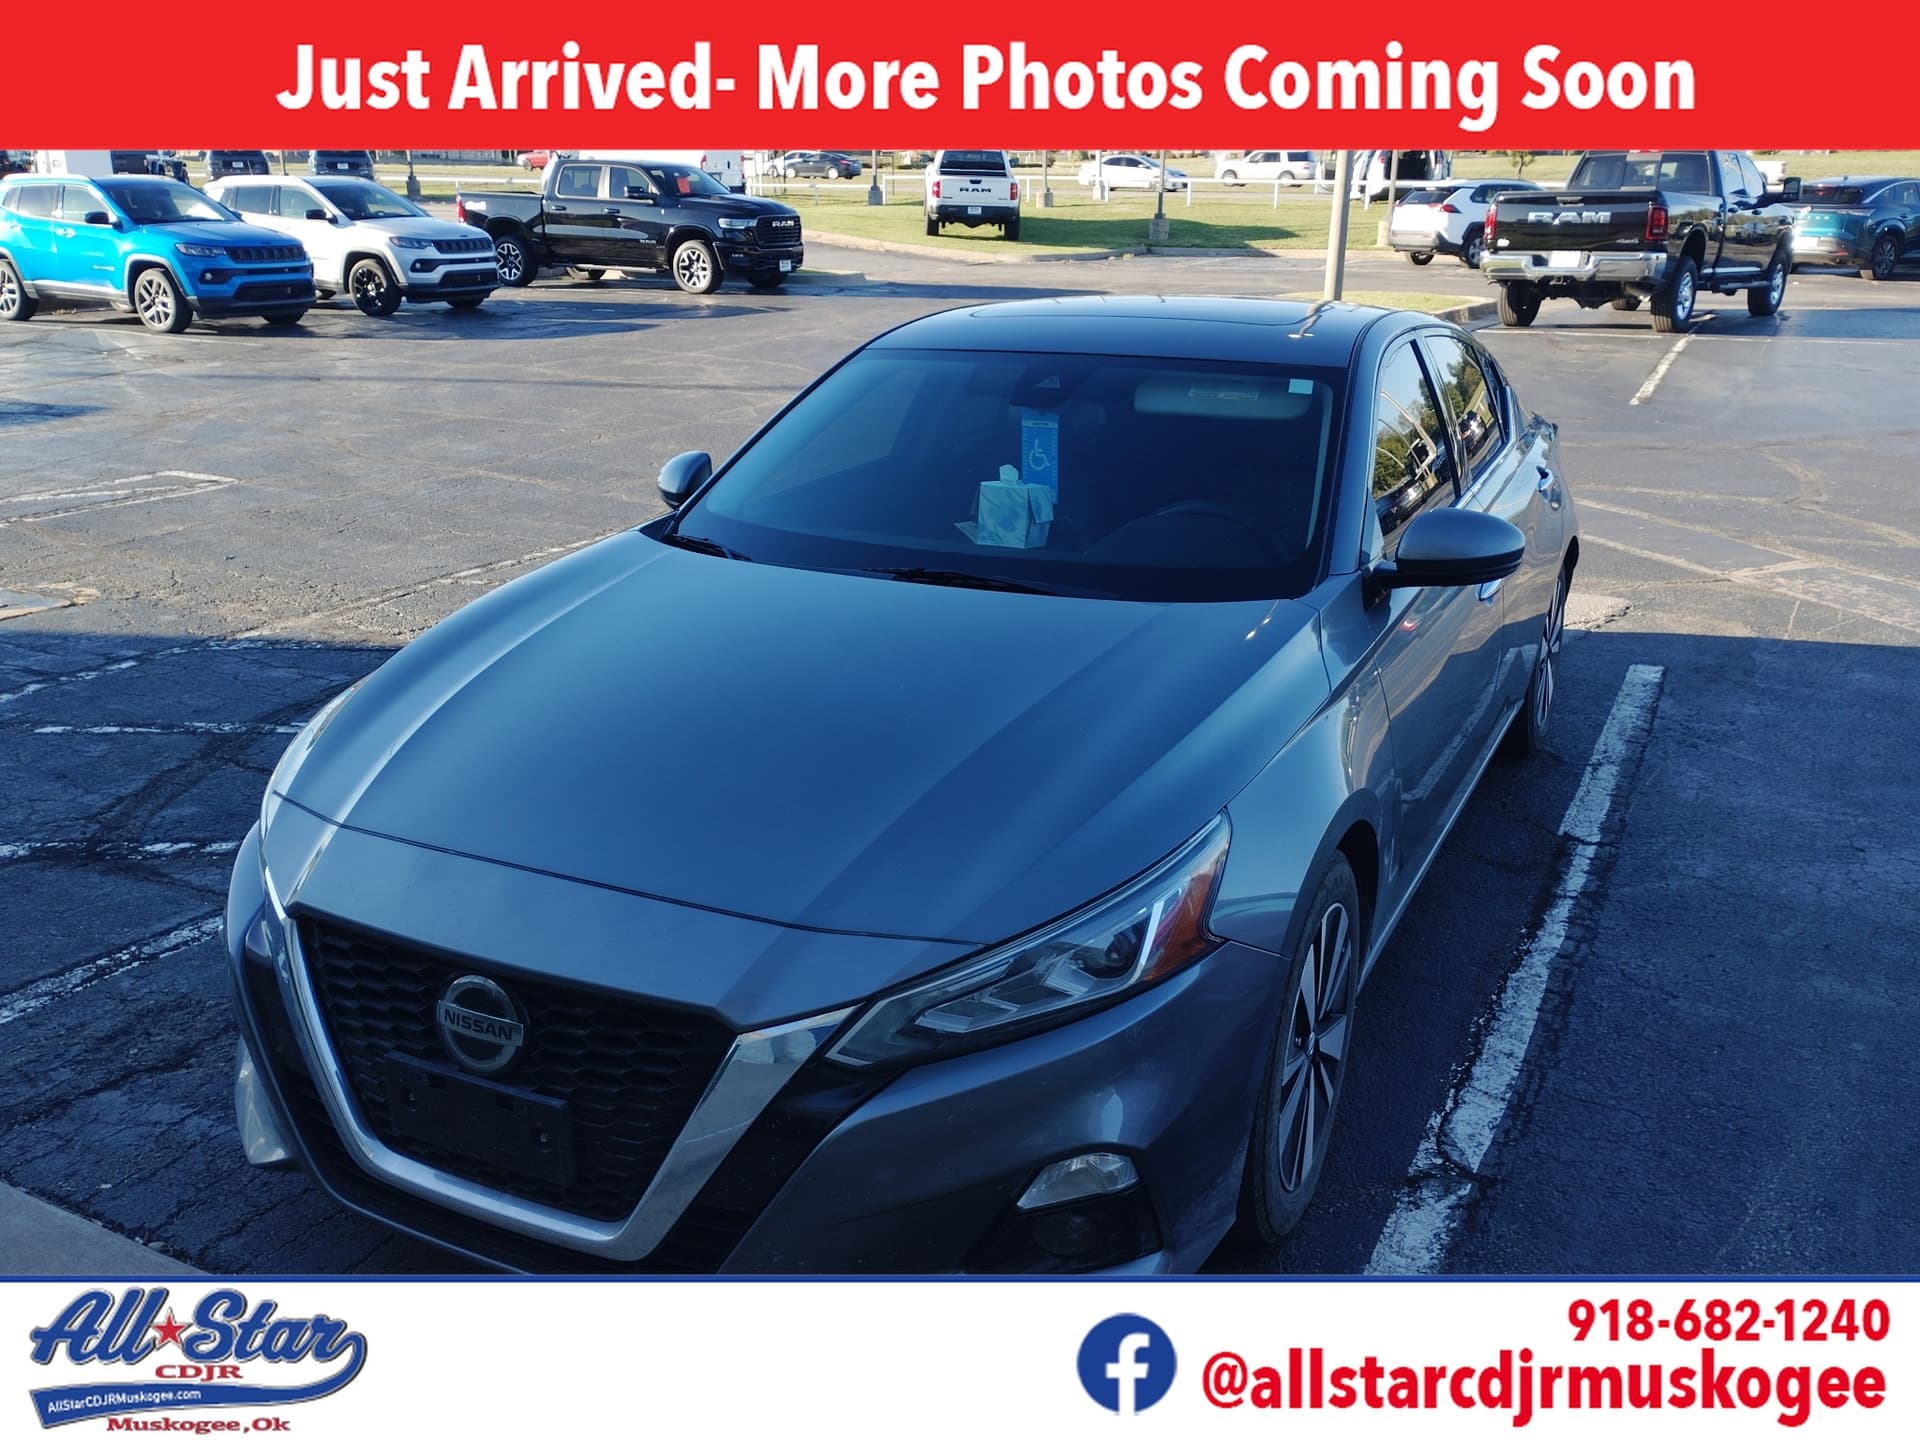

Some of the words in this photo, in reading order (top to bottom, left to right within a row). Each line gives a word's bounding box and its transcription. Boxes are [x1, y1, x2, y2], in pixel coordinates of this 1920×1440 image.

[772, 219, 795, 228] RAM
[1527, 211, 1611, 225] RAM
[444, 1008, 513, 1041] NISSAN
